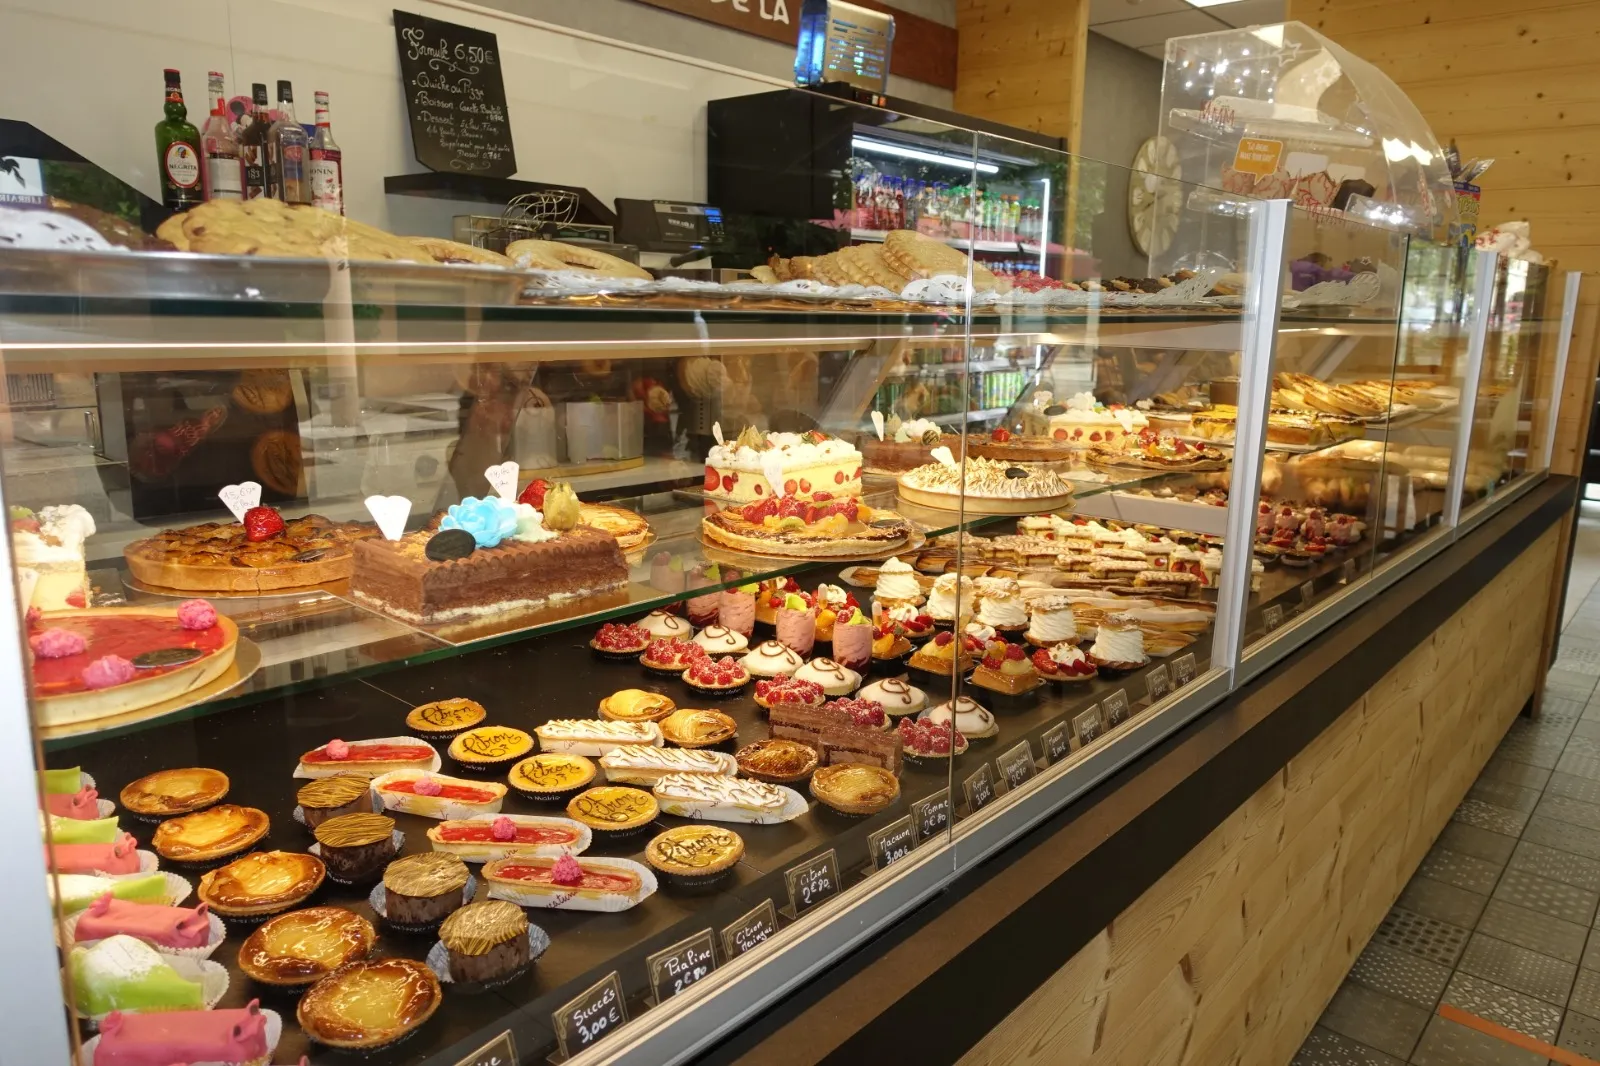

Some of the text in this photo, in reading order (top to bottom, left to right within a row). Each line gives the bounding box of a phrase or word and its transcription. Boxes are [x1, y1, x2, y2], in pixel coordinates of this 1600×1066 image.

[760, 0, 790, 25] LA
[416, 71, 449, 91] Quiche
[458, 78, 485, 100] Pizza
[417, 90, 454, 109] Boisson
[169, 163, 198, 171] NEGRITA
[920, 799, 949, 817] Pomme
[922, 814, 947, 836] 2€80
[880, 828, 911, 850] Macaron
[800, 864, 828, 886] Citron
[736, 920, 763, 945] Citron
[664, 948, 711, 976] Praline
[674, 965, 708, 995] 2€80
